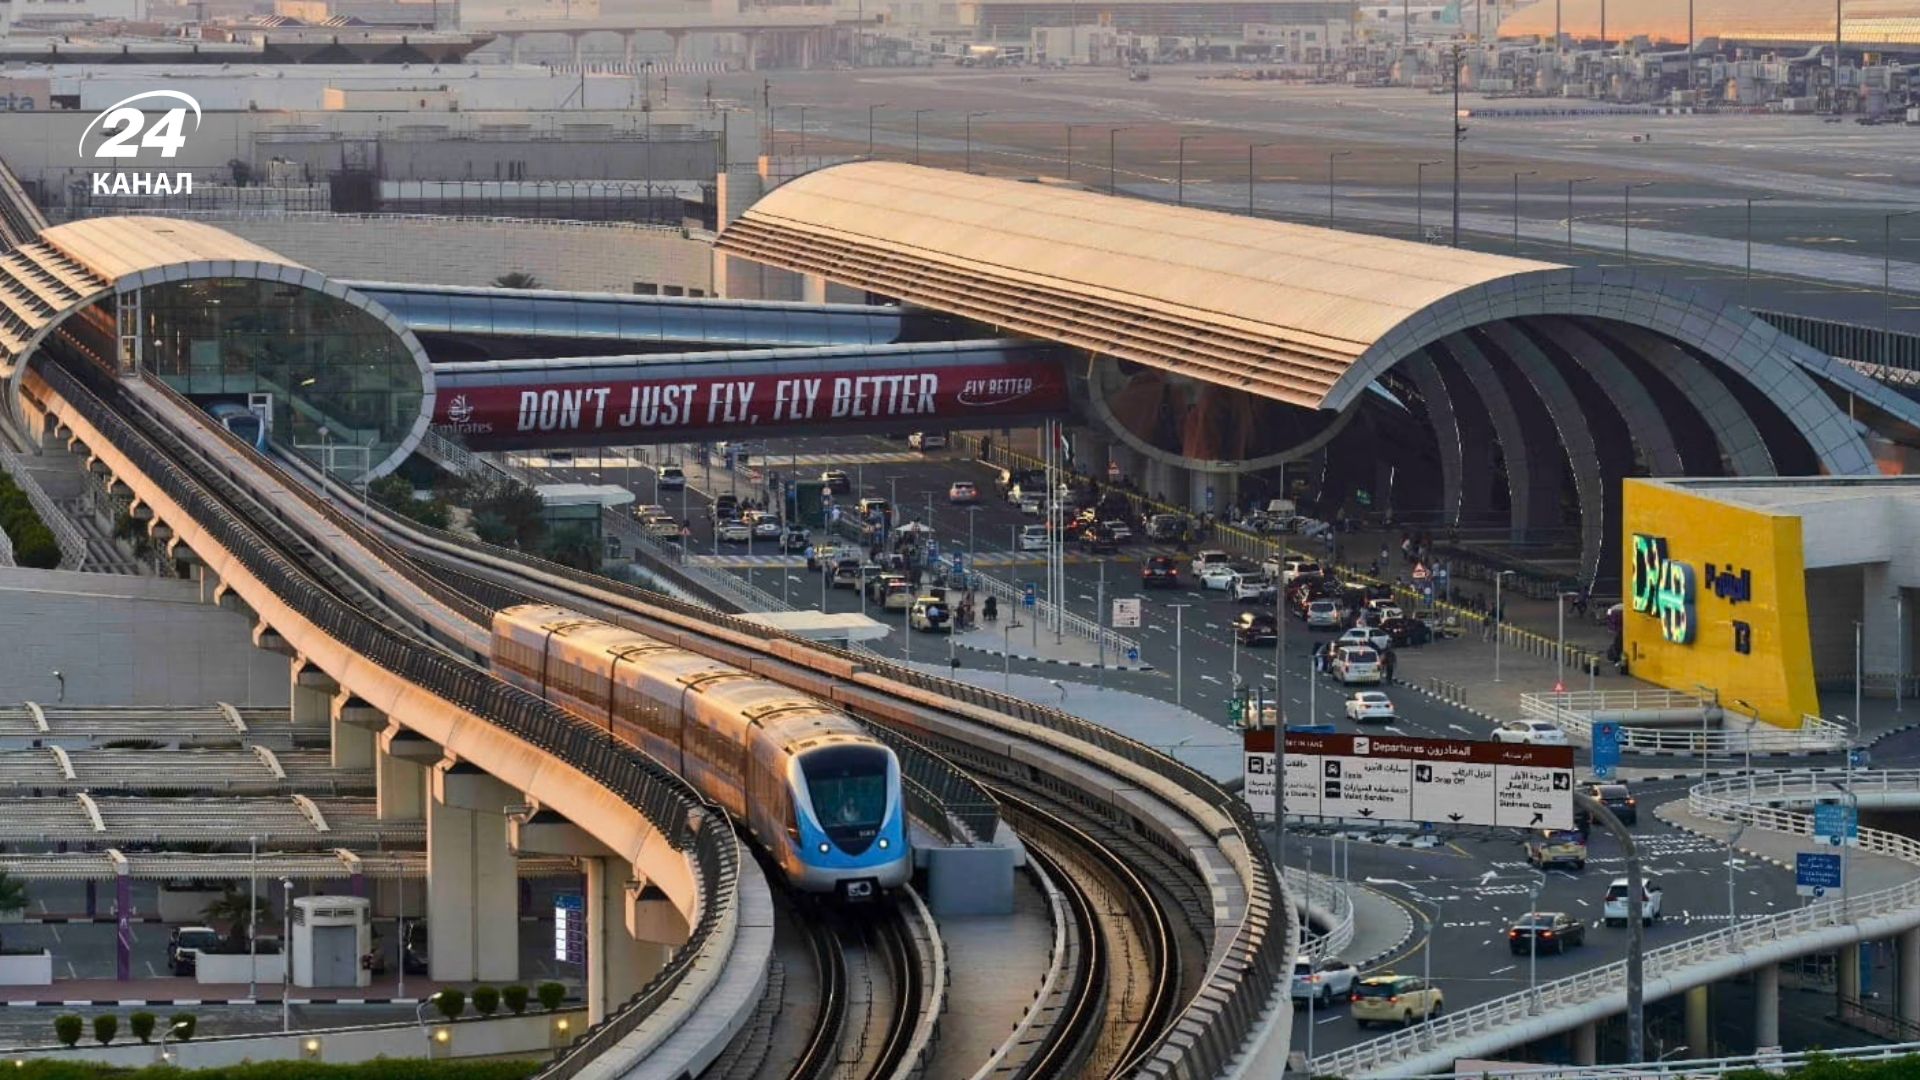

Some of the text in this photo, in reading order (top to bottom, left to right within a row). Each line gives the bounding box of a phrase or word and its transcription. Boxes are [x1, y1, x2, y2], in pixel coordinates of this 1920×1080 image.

[964, 377, 1032, 395] FLY BETTER
[517, 373, 938, 432] DON'T JUST FLY, FLY BETTER
[1372, 741, 1425, 754] Departures
[1427, 745, 1472, 757] المغادرون
[1434, 775, 1452, 785] Drop
